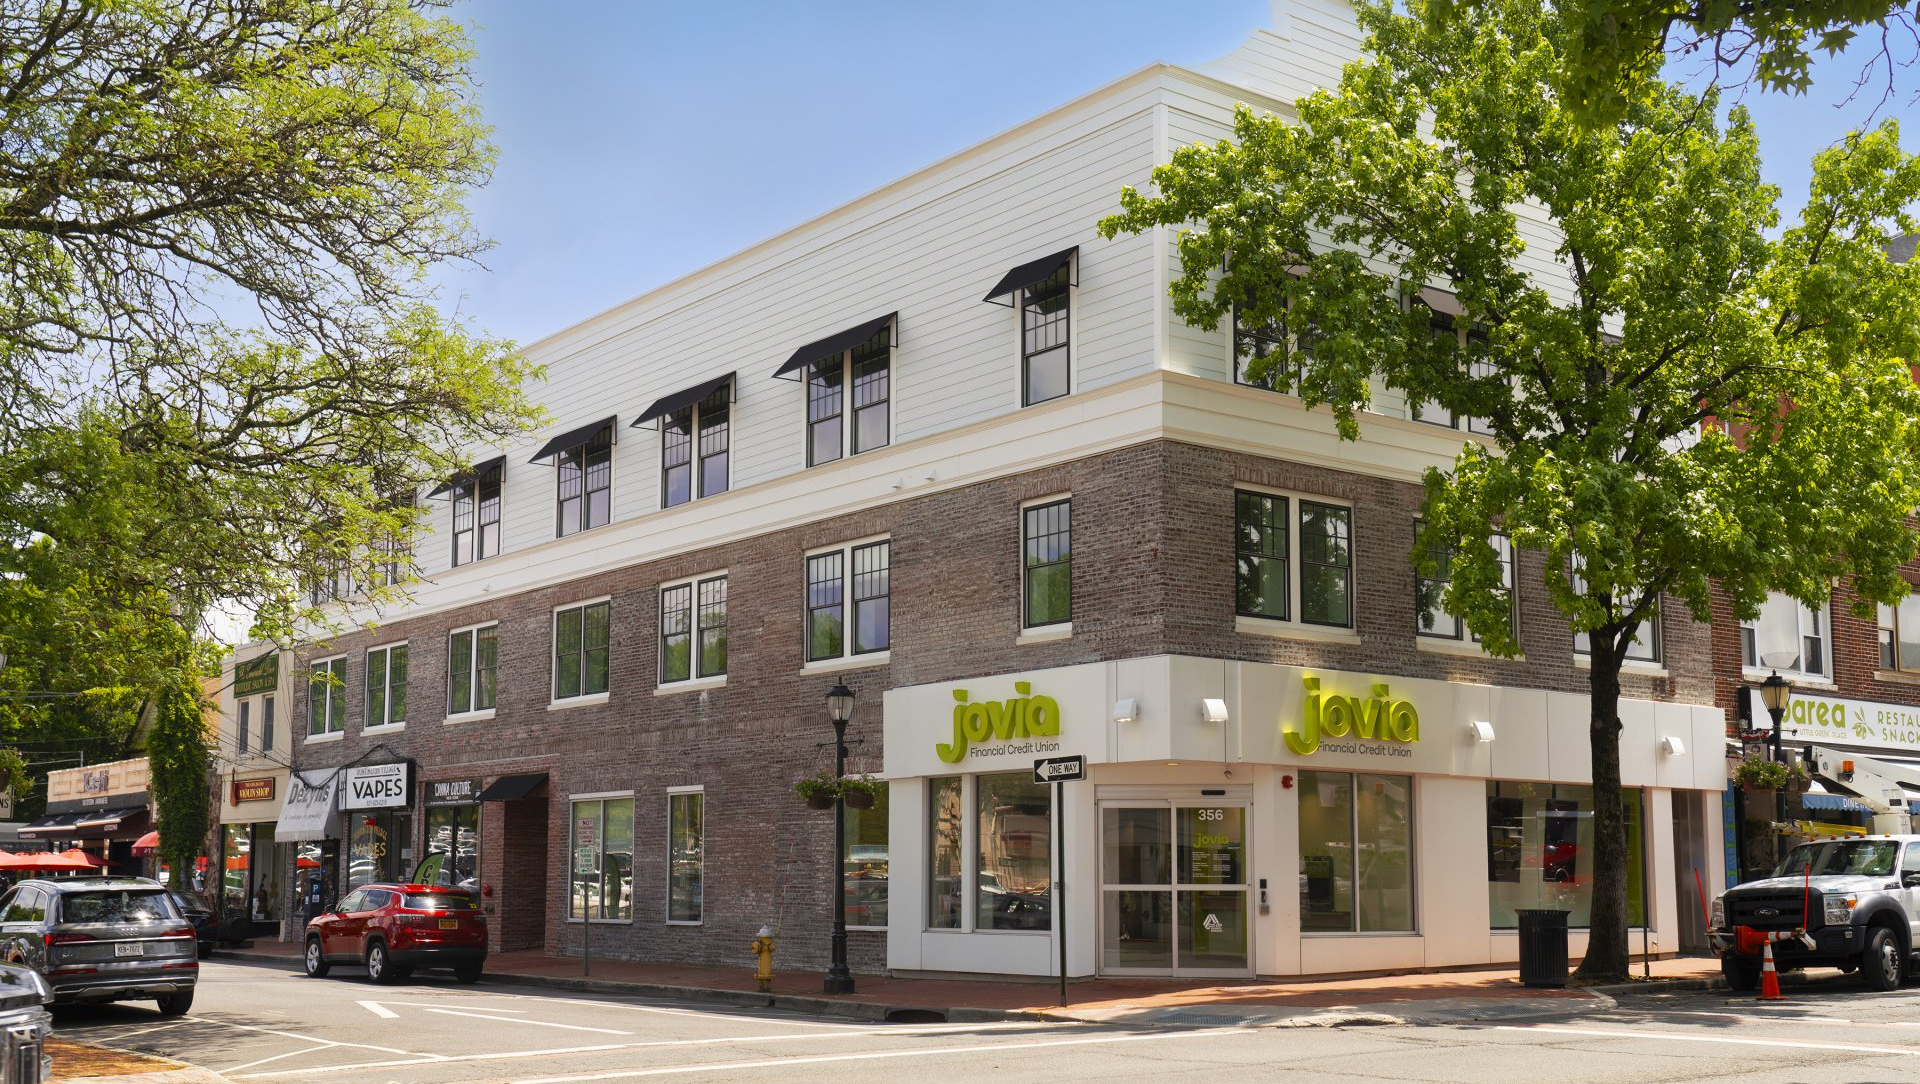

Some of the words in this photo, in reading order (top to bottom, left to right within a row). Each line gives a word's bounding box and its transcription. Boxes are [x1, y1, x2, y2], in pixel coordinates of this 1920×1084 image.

[936, 681, 1060, 763] jovia
[1283, 677, 1419, 755] jovia
[970, 745, 1006, 758] Financial
[1007, 743, 1034, 755] Credit
[1035, 741, 1060, 753] Union
[1318, 741, 1357, 754] Financial
[1358, 743, 1386, 756] Credit
[1387, 745, 1412, 758] Union
[1048, 764, 1062, 775] ONE
[1063, 762, 1078, 773] WAY
[256, 787, 269, 797] SHOP
[352, 778, 403, 799] VAPES
[451, 781, 471, 796] CULTURE
[1843, 798, 1859, 809] DINE
[1198, 809, 1223, 821] 356
[1193, 832, 1229, 848] jovia
[354, 842, 386, 857] VAPES
[313, 884, 319, 893] P
